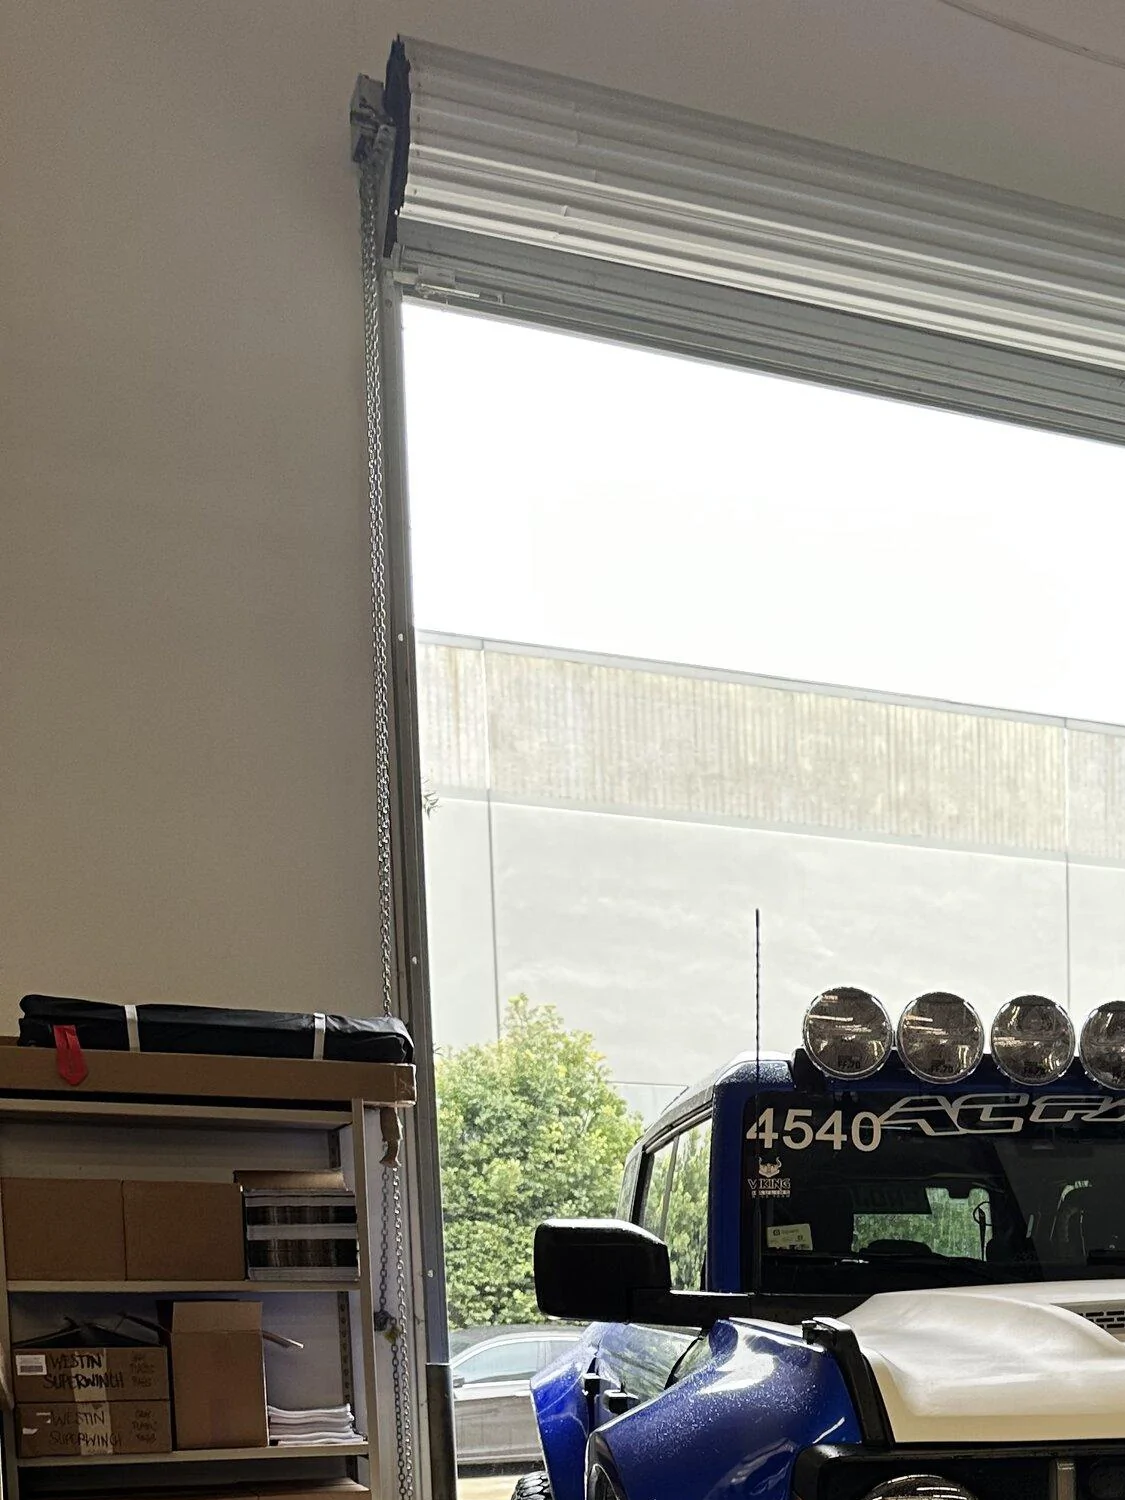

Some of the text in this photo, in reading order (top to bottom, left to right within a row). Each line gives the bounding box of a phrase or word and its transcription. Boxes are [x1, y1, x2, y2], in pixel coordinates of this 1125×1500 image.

[746, 1107, 882, 1152] 4540
[747, 1178, 791, 1190] VKING
[49, 1352, 103, 1370] WESTIN
[43, 1371, 125, 1390] SUPERWINCH
[50, 1411, 106, 1427] WESTIN
